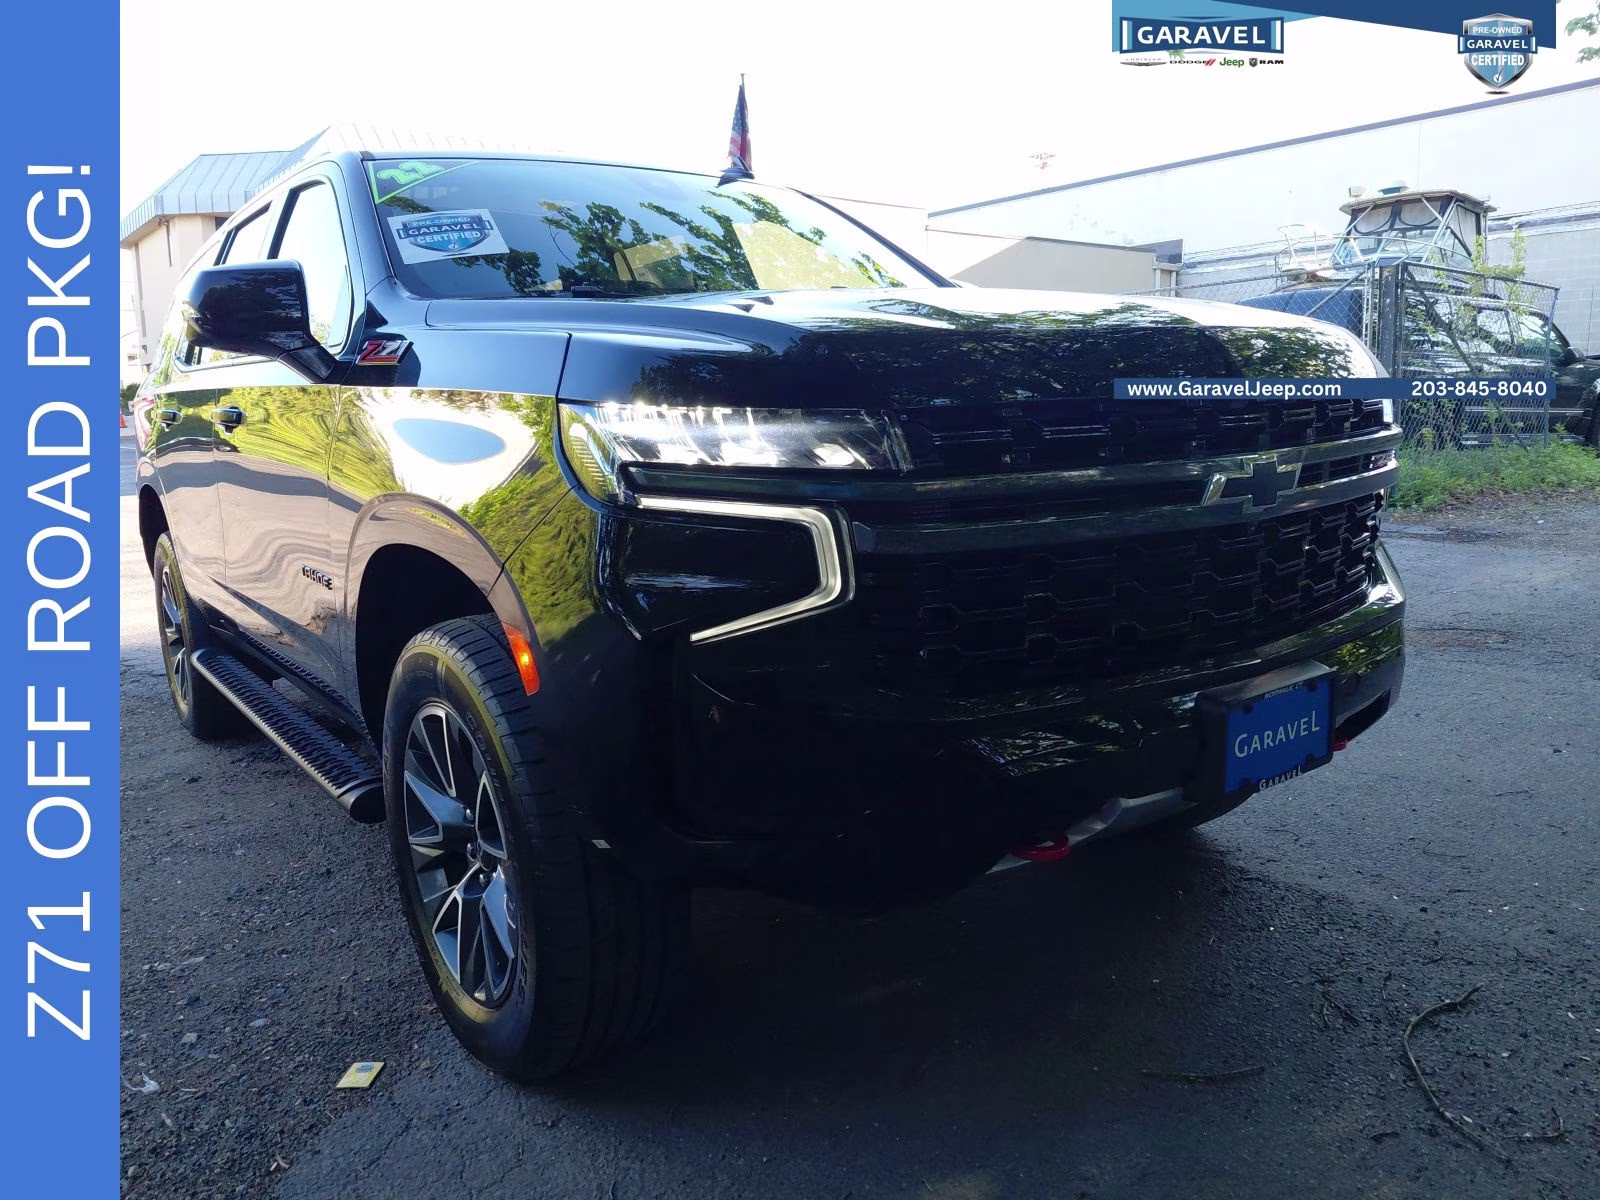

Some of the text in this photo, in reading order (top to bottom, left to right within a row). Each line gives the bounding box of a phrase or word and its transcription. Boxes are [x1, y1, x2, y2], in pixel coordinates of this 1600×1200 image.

[408, 223, 482, 235] GARAVEL
[412, 216, 471, 227] PRE-OWNED
[417, 230, 481, 244] CERTIFIED
[356, 339, 411, 366] Z71
[1234, 710, 1321, 758] GARAVEL
[1259, 765, 1303, 790] GARAVEL
